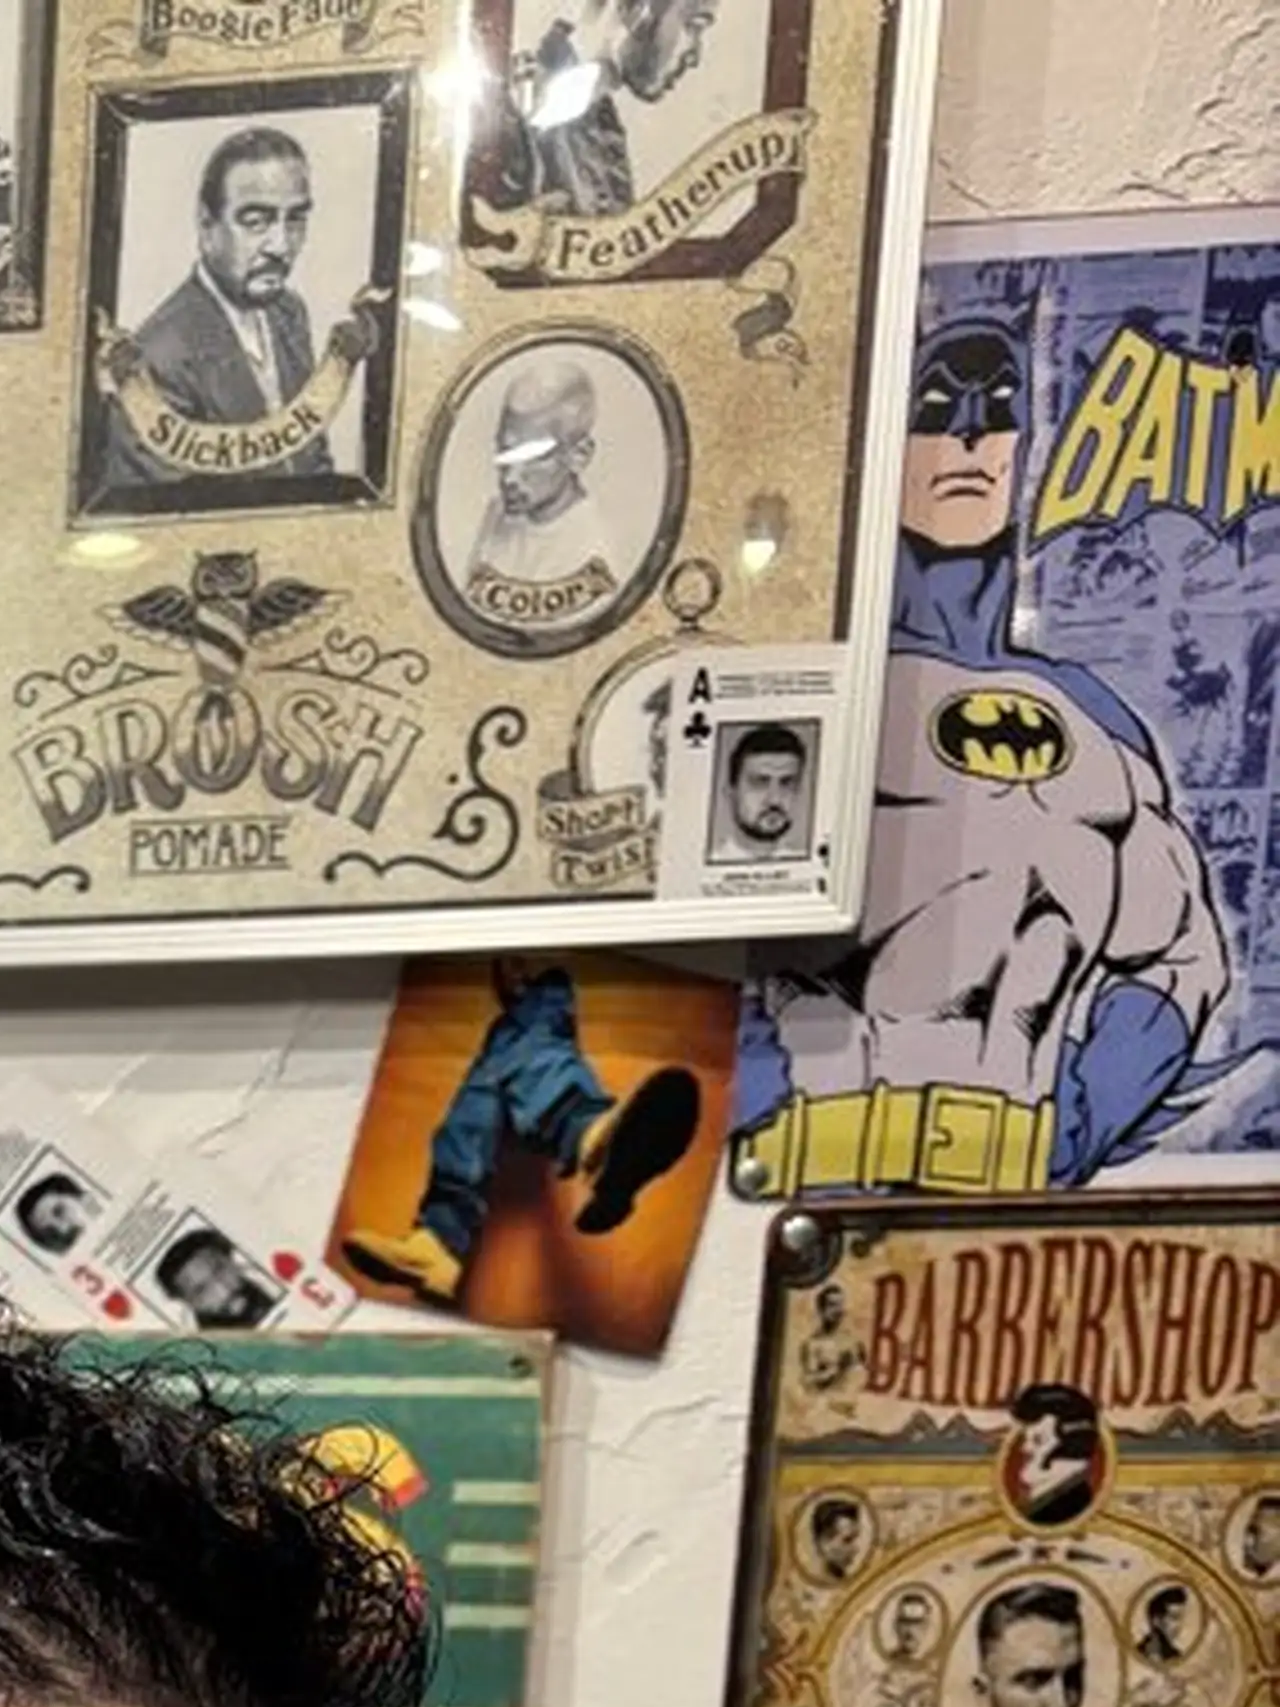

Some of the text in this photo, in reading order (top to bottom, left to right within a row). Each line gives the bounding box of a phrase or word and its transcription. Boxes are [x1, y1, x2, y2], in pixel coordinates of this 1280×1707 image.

[146, 405, 323, 470] Slickback
[486, 578, 585, 617] Color
[688, 667, 712, 703] A
[131, 818, 290, 868] POMADE
[864, 1236, 1280, 1409] BARBERSHOP
